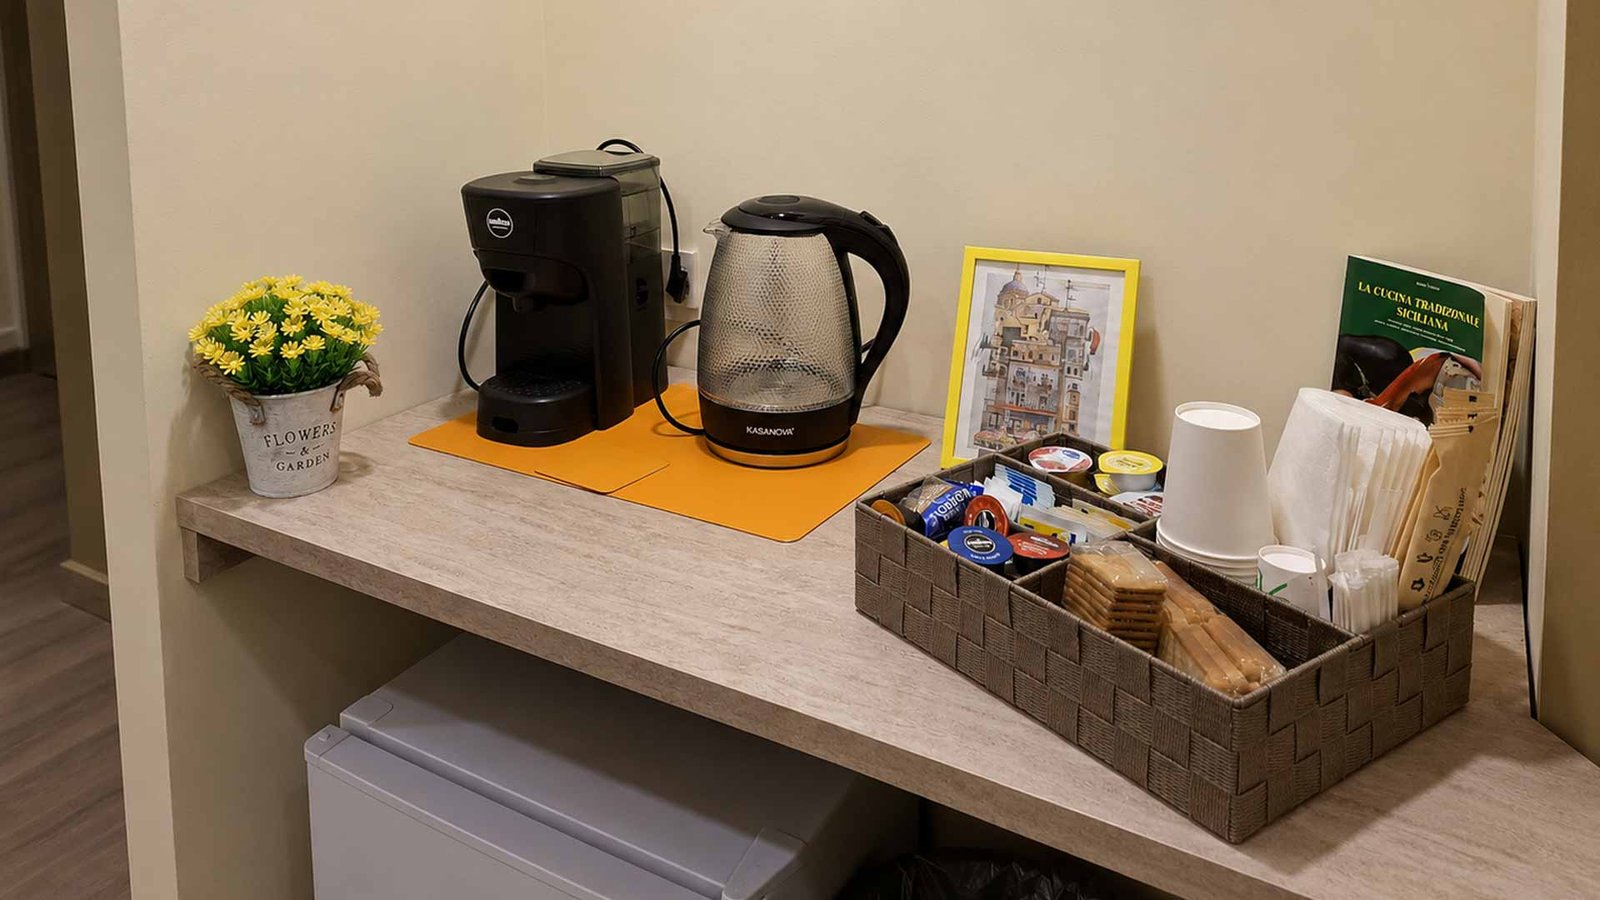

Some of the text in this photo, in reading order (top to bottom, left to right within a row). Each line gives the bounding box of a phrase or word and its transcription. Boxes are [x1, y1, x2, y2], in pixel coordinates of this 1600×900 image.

[1358, 281, 1371, 294] LA
[1373, 286, 1412, 306] CUCINA
[1396, 307, 1449, 332] SICILIANA
[264, 421, 336, 447] FLOWERS
[746, 426, 794, 436] KASANOVA
[276, 452, 329, 471] GARDEN
[300, 446, 310, 456] &
